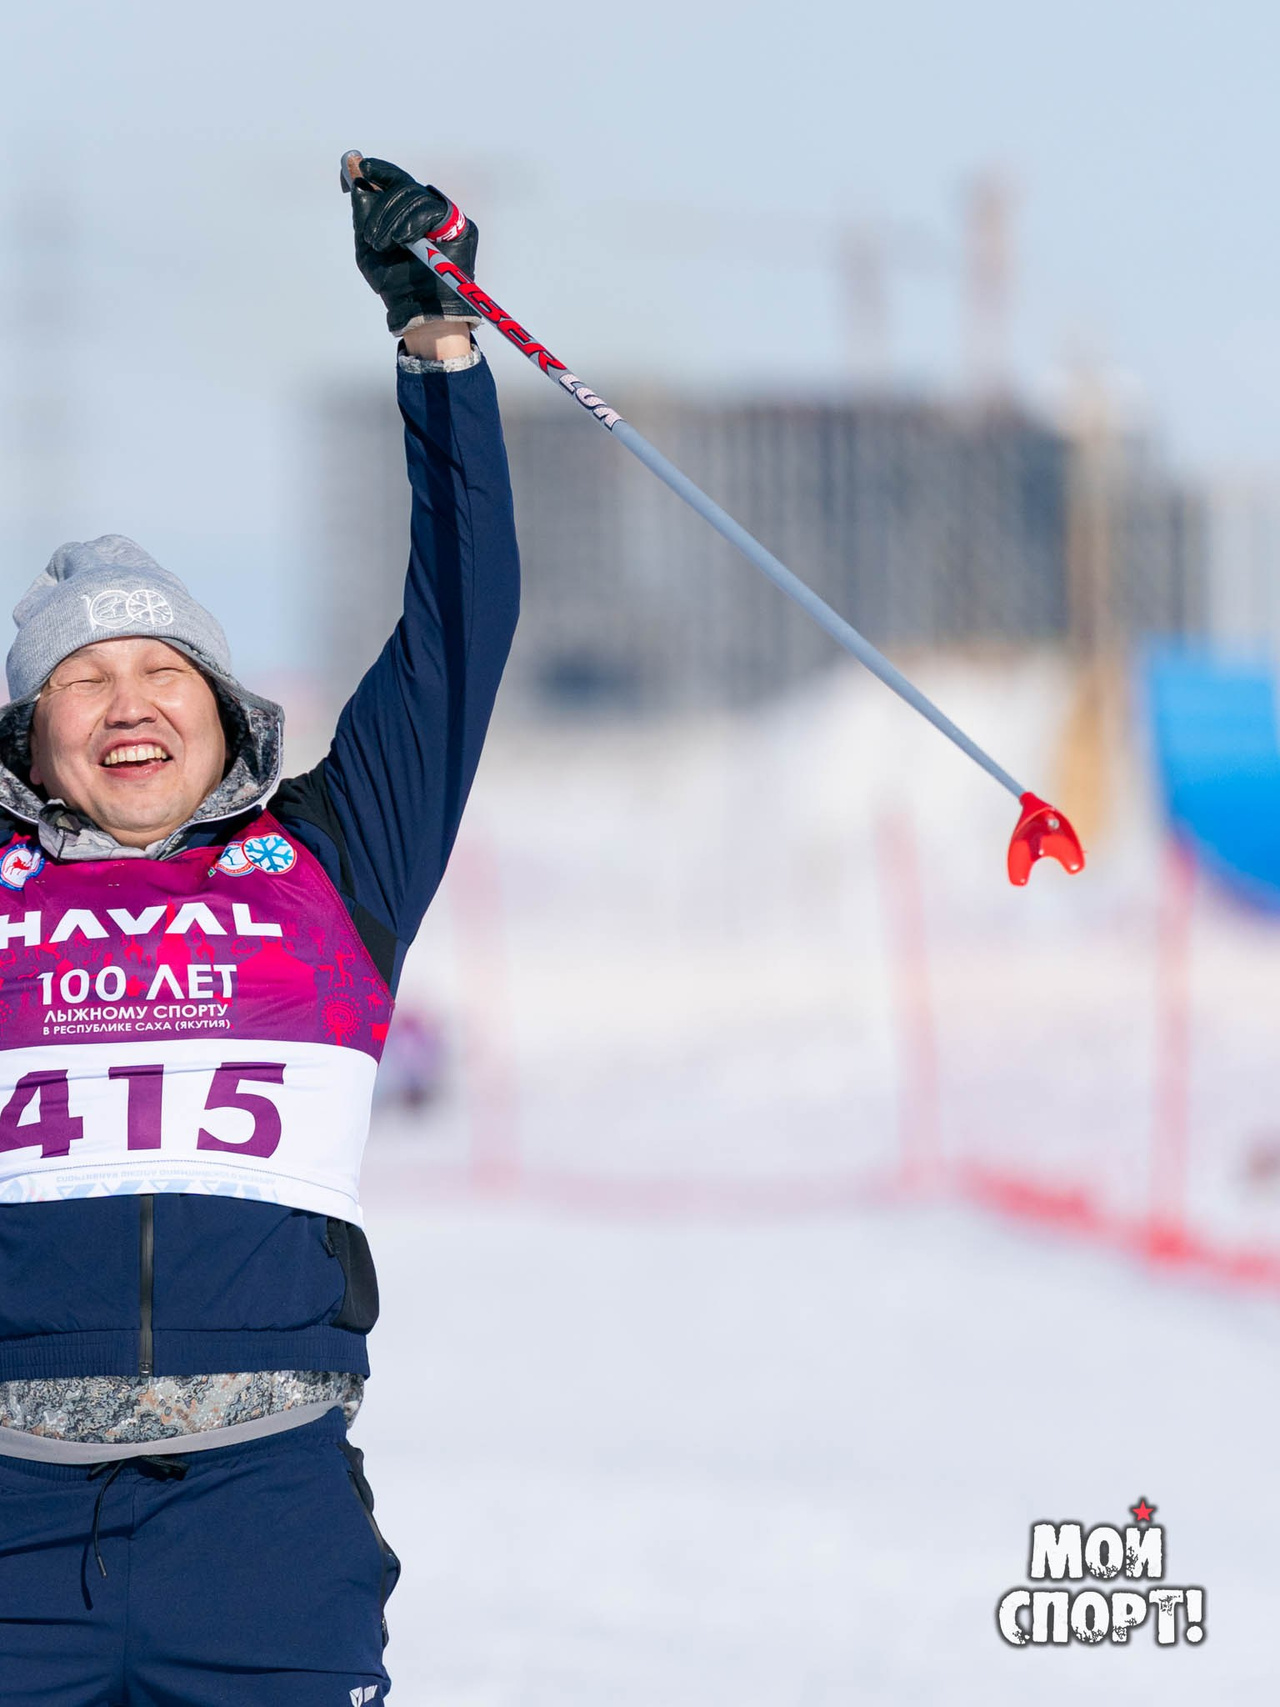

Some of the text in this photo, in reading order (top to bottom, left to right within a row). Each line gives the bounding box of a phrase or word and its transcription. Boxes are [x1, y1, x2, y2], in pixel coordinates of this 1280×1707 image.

[434, 261, 625, 430] FIBER LUX
[37, 964, 238, 1006] 100 ЛЕТ
[43, 1003, 229, 1023] ЛЫЖНОМУ СПОРТУ
[43, 1018, 232, 1036] В РЕСПУБЛИКЕ САХА (ЯКУТИЯ)
